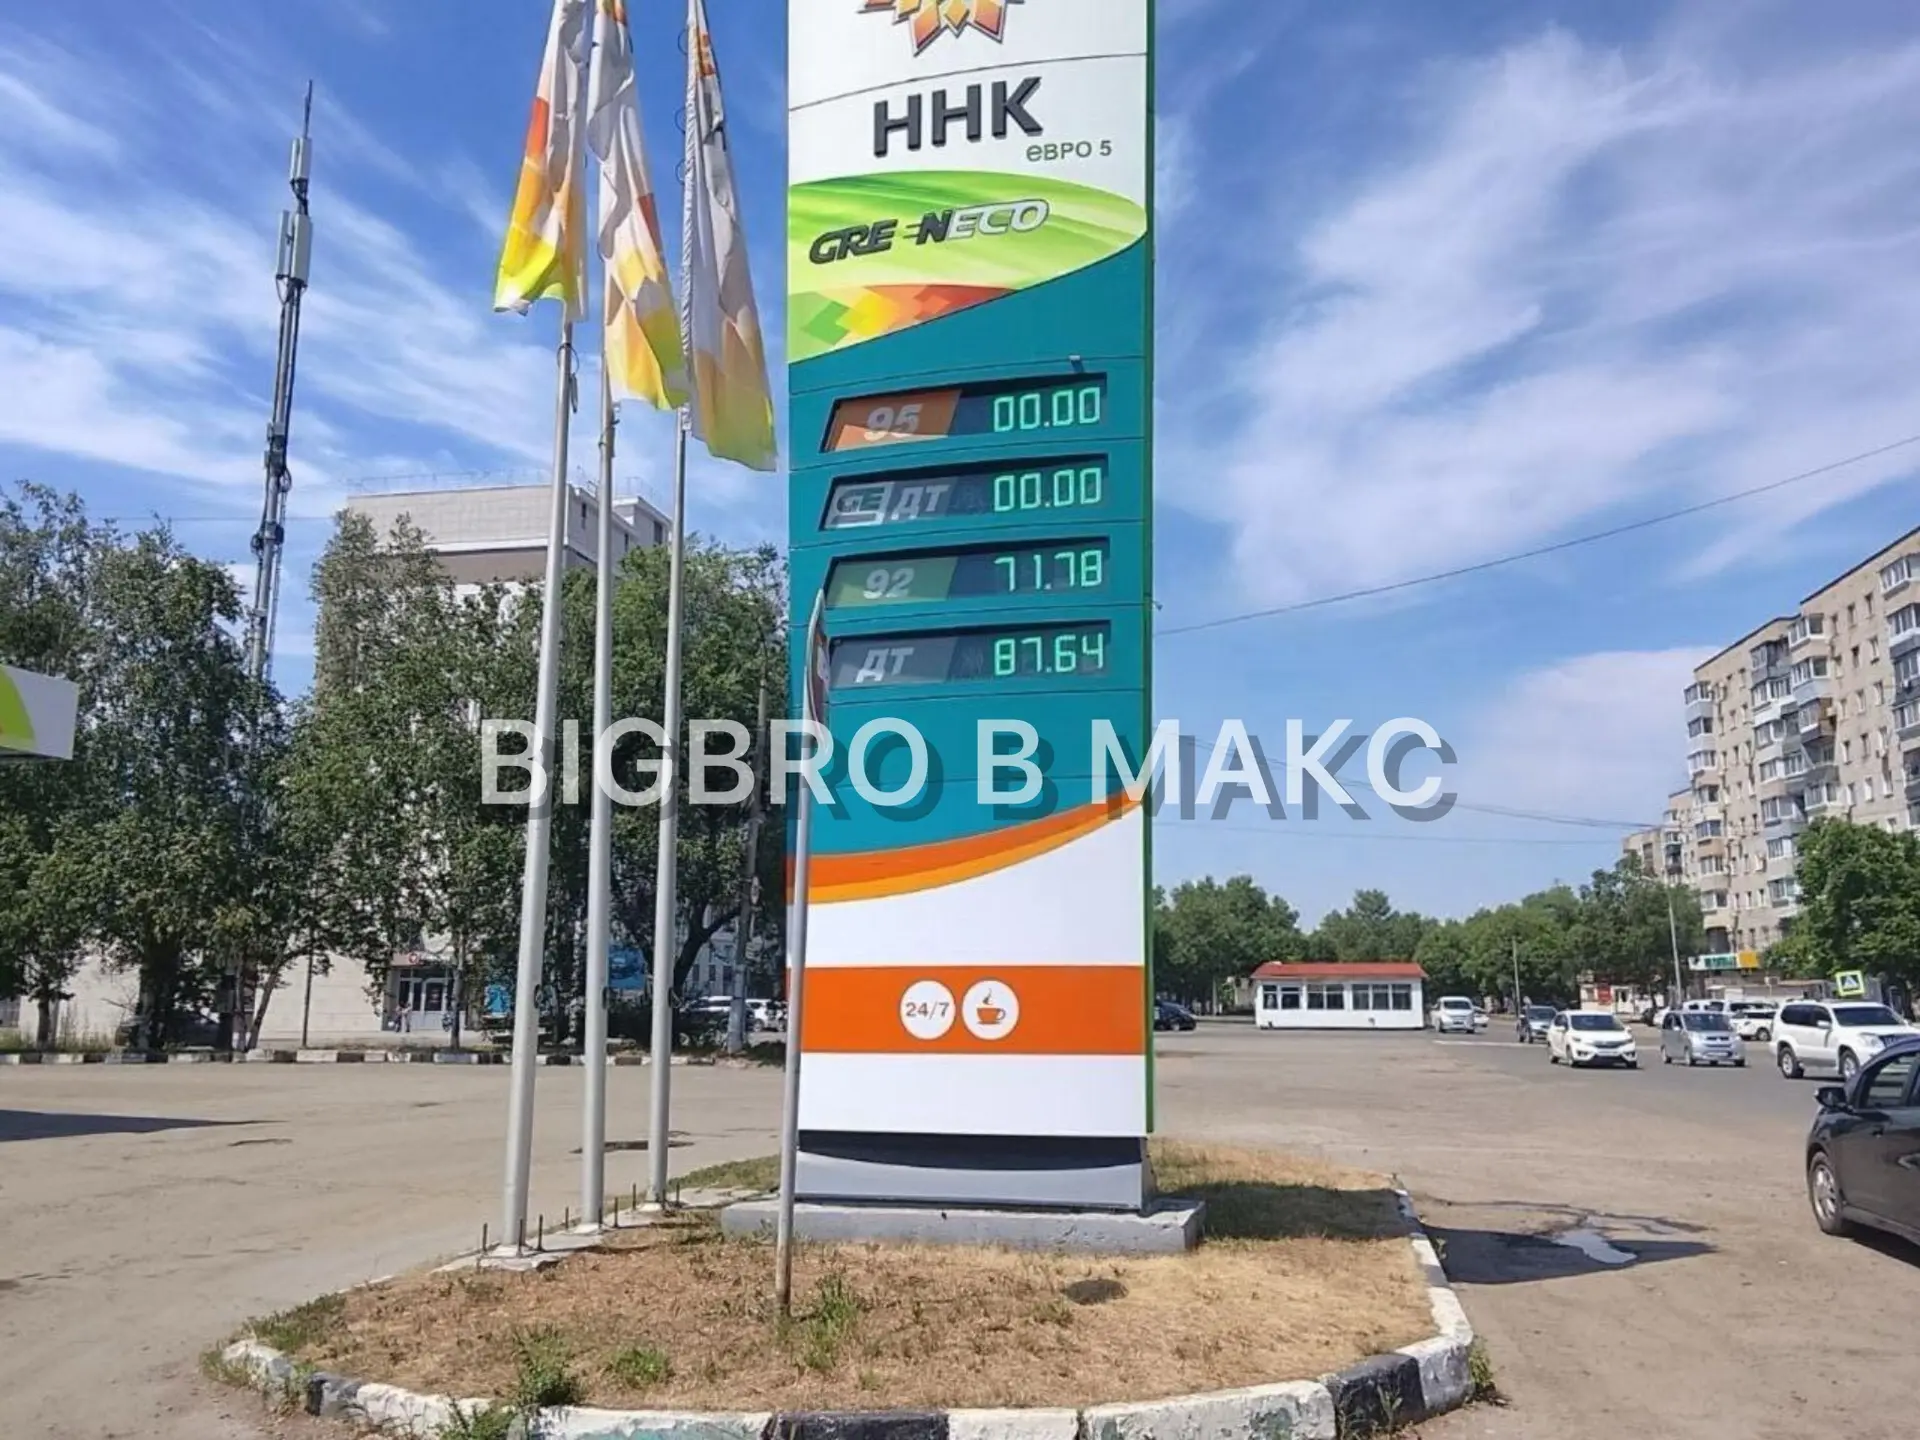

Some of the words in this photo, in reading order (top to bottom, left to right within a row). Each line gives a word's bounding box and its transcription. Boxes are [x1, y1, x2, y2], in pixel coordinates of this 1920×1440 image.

[874, 76, 1044, 158] ННК
[1099, 140, 1113, 157] 5
[865, 404, 922, 441] 95
[993, 386, 1101, 432] 00.00
[891, 484, 951, 520] ДТ
[993, 467, 1102, 512] 00.00
[863, 567, 915, 600] 92
[994, 549, 1103, 591] 71.78
[855, 647, 914, 683] ДТ
[995, 632, 1105, 676] 87.64
[905, 1000, 950, 1020] 24/7
